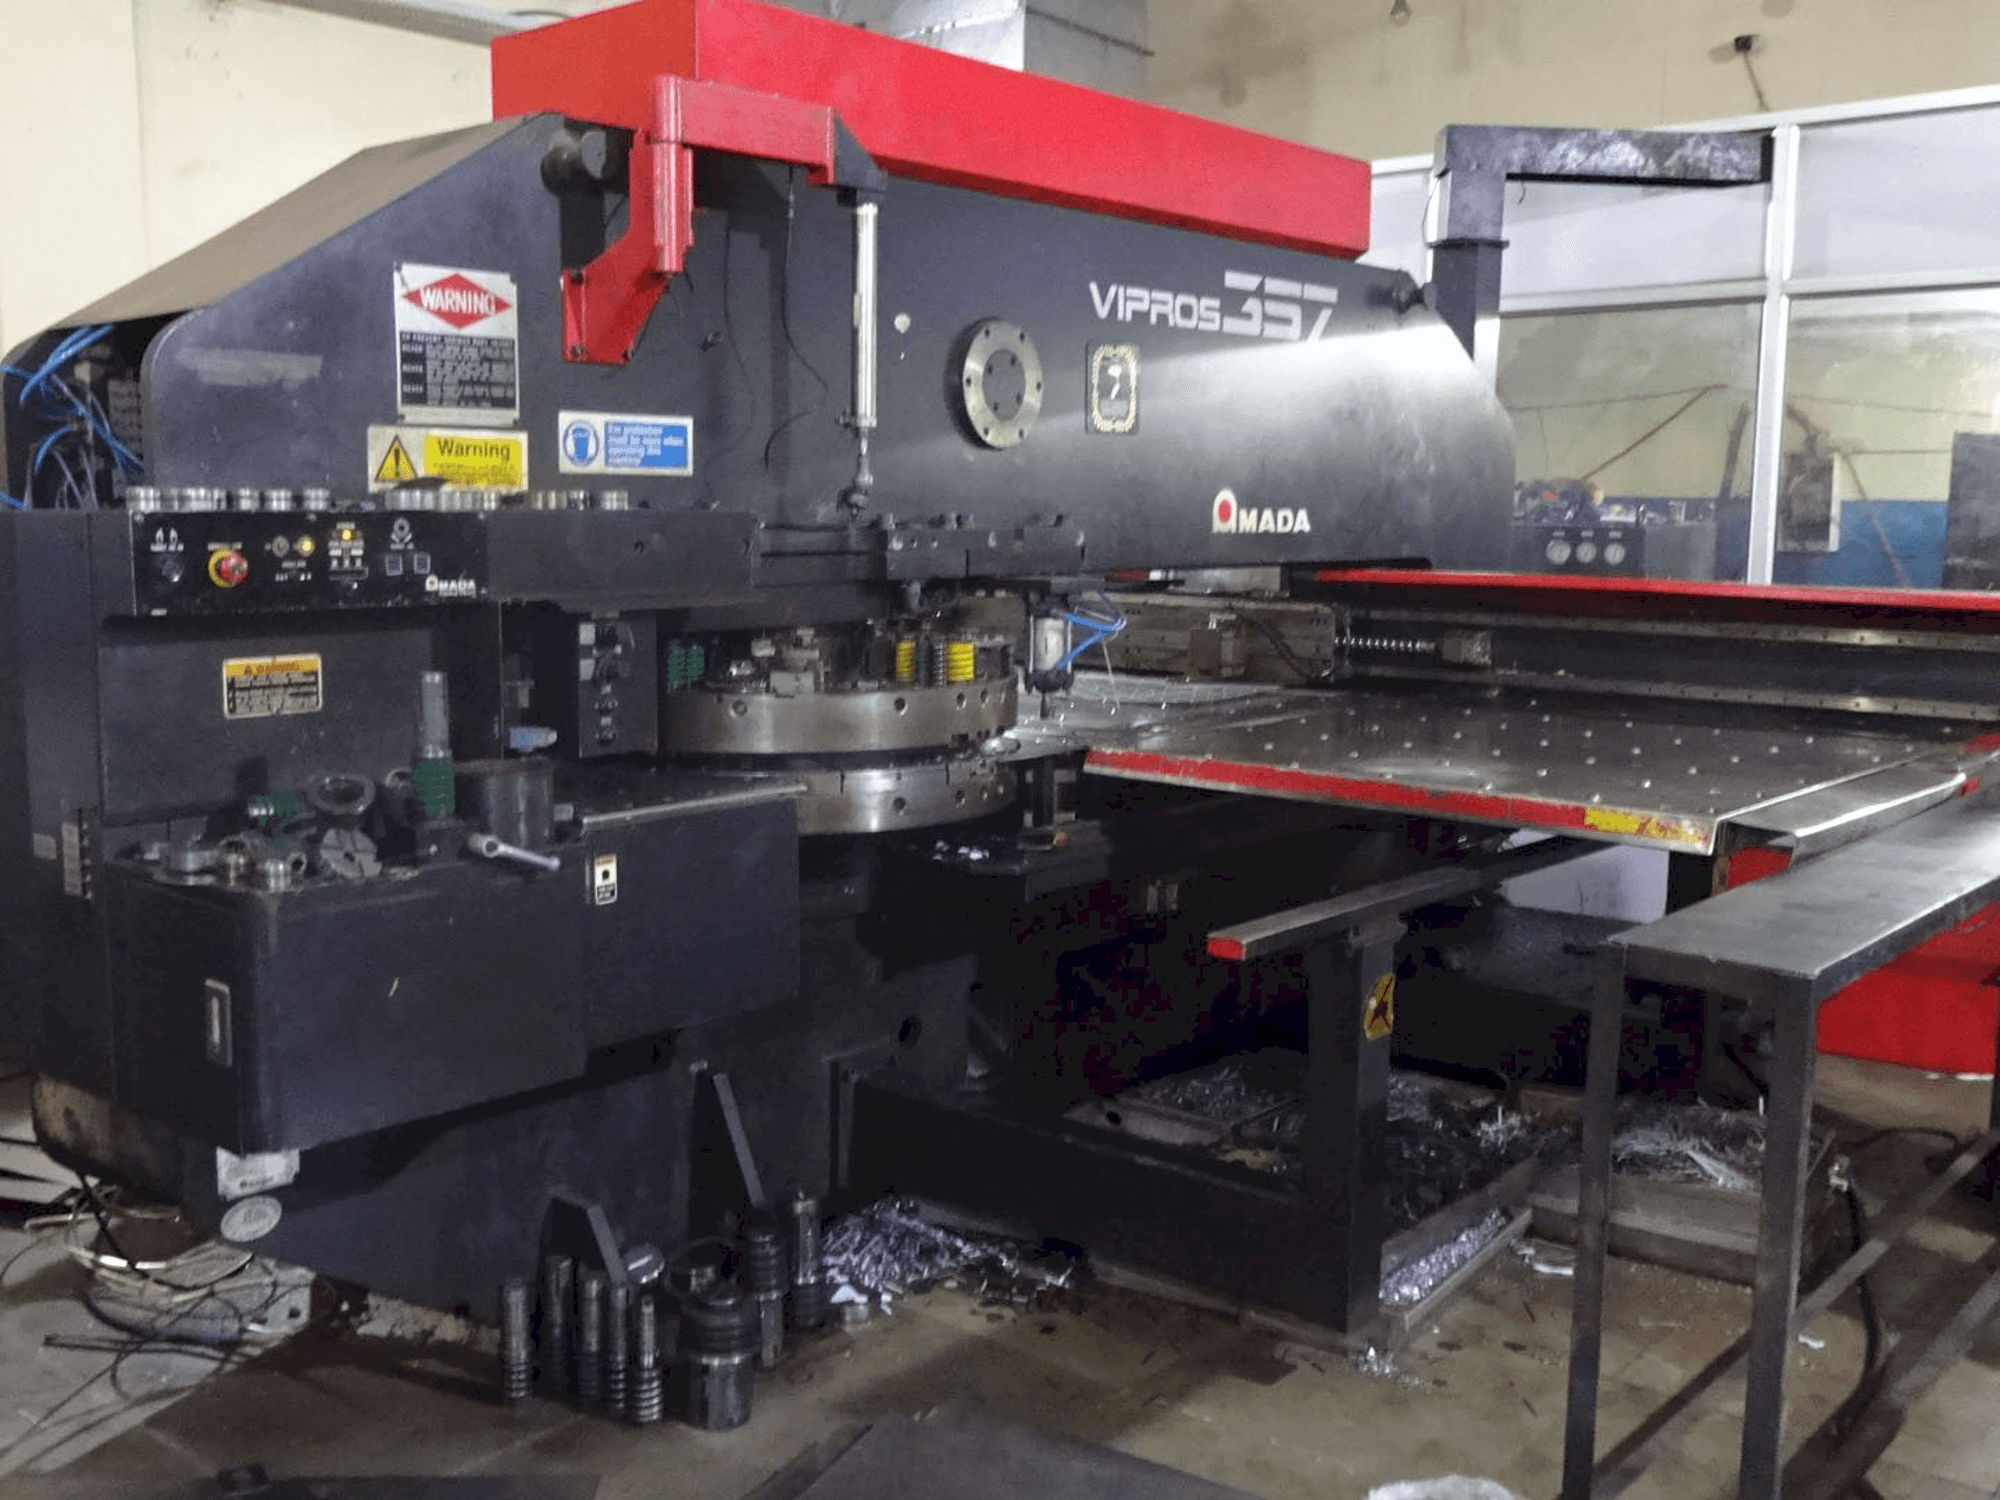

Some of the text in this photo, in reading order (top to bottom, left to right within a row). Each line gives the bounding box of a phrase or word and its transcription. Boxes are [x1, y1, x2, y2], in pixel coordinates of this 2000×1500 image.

[420, 287, 496, 315] WARNING
[1089, 280, 1221, 332] VIPROS
[436, 437, 510, 462] Warning
